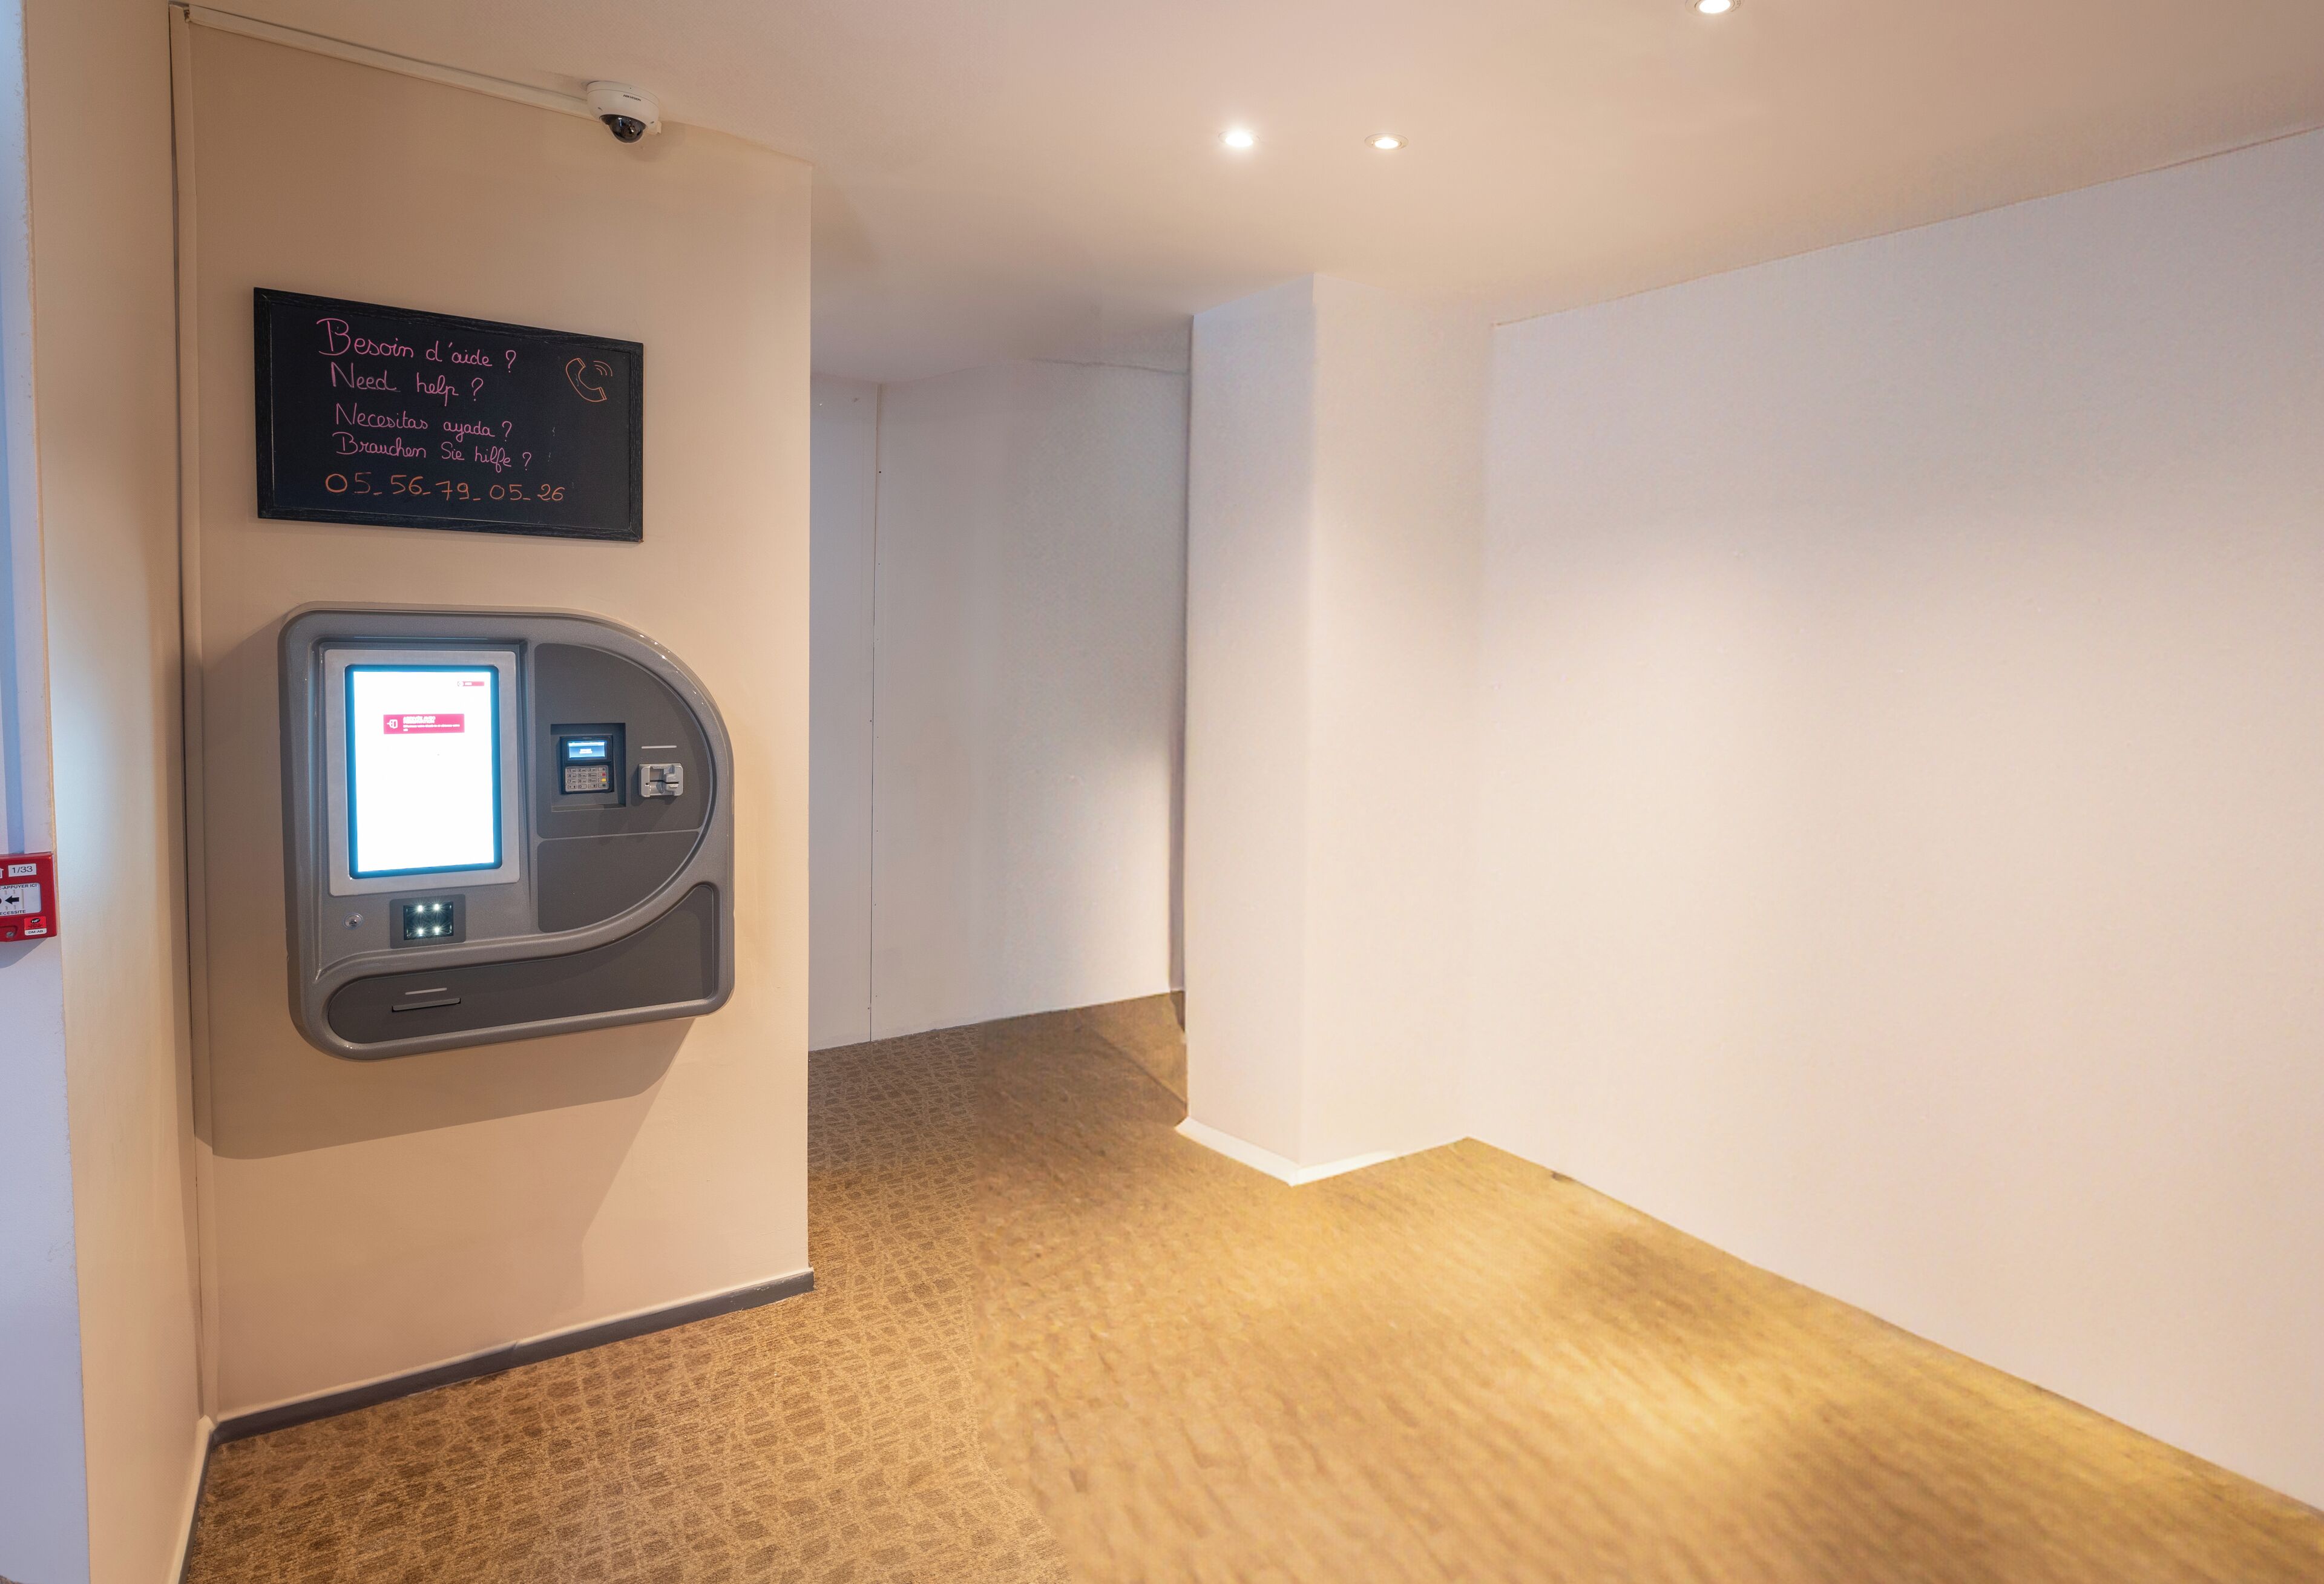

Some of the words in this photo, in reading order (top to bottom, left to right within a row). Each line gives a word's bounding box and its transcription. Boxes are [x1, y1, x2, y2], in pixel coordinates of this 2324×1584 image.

[316, 318, 414, 358] Besoin
[425, 340, 493, 367] d'aide
[505, 350, 517, 373] ?
[330, 361, 398, 390] Need
[416, 372, 459, 407] help
[471, 377, 484, 401] ?
[336, 403, 428, 429] Necesitas
[443, 421, 495, 443] ayada
[502, 421, 512, 442] ?
[332, 432, 426, 458] Brauchen
[441, 441, 465, 461] Sie
[474, 445, 512, 473] hilfe
[522, 452, 532, 471] ?
[11, 866, 33, 874] 1/33
